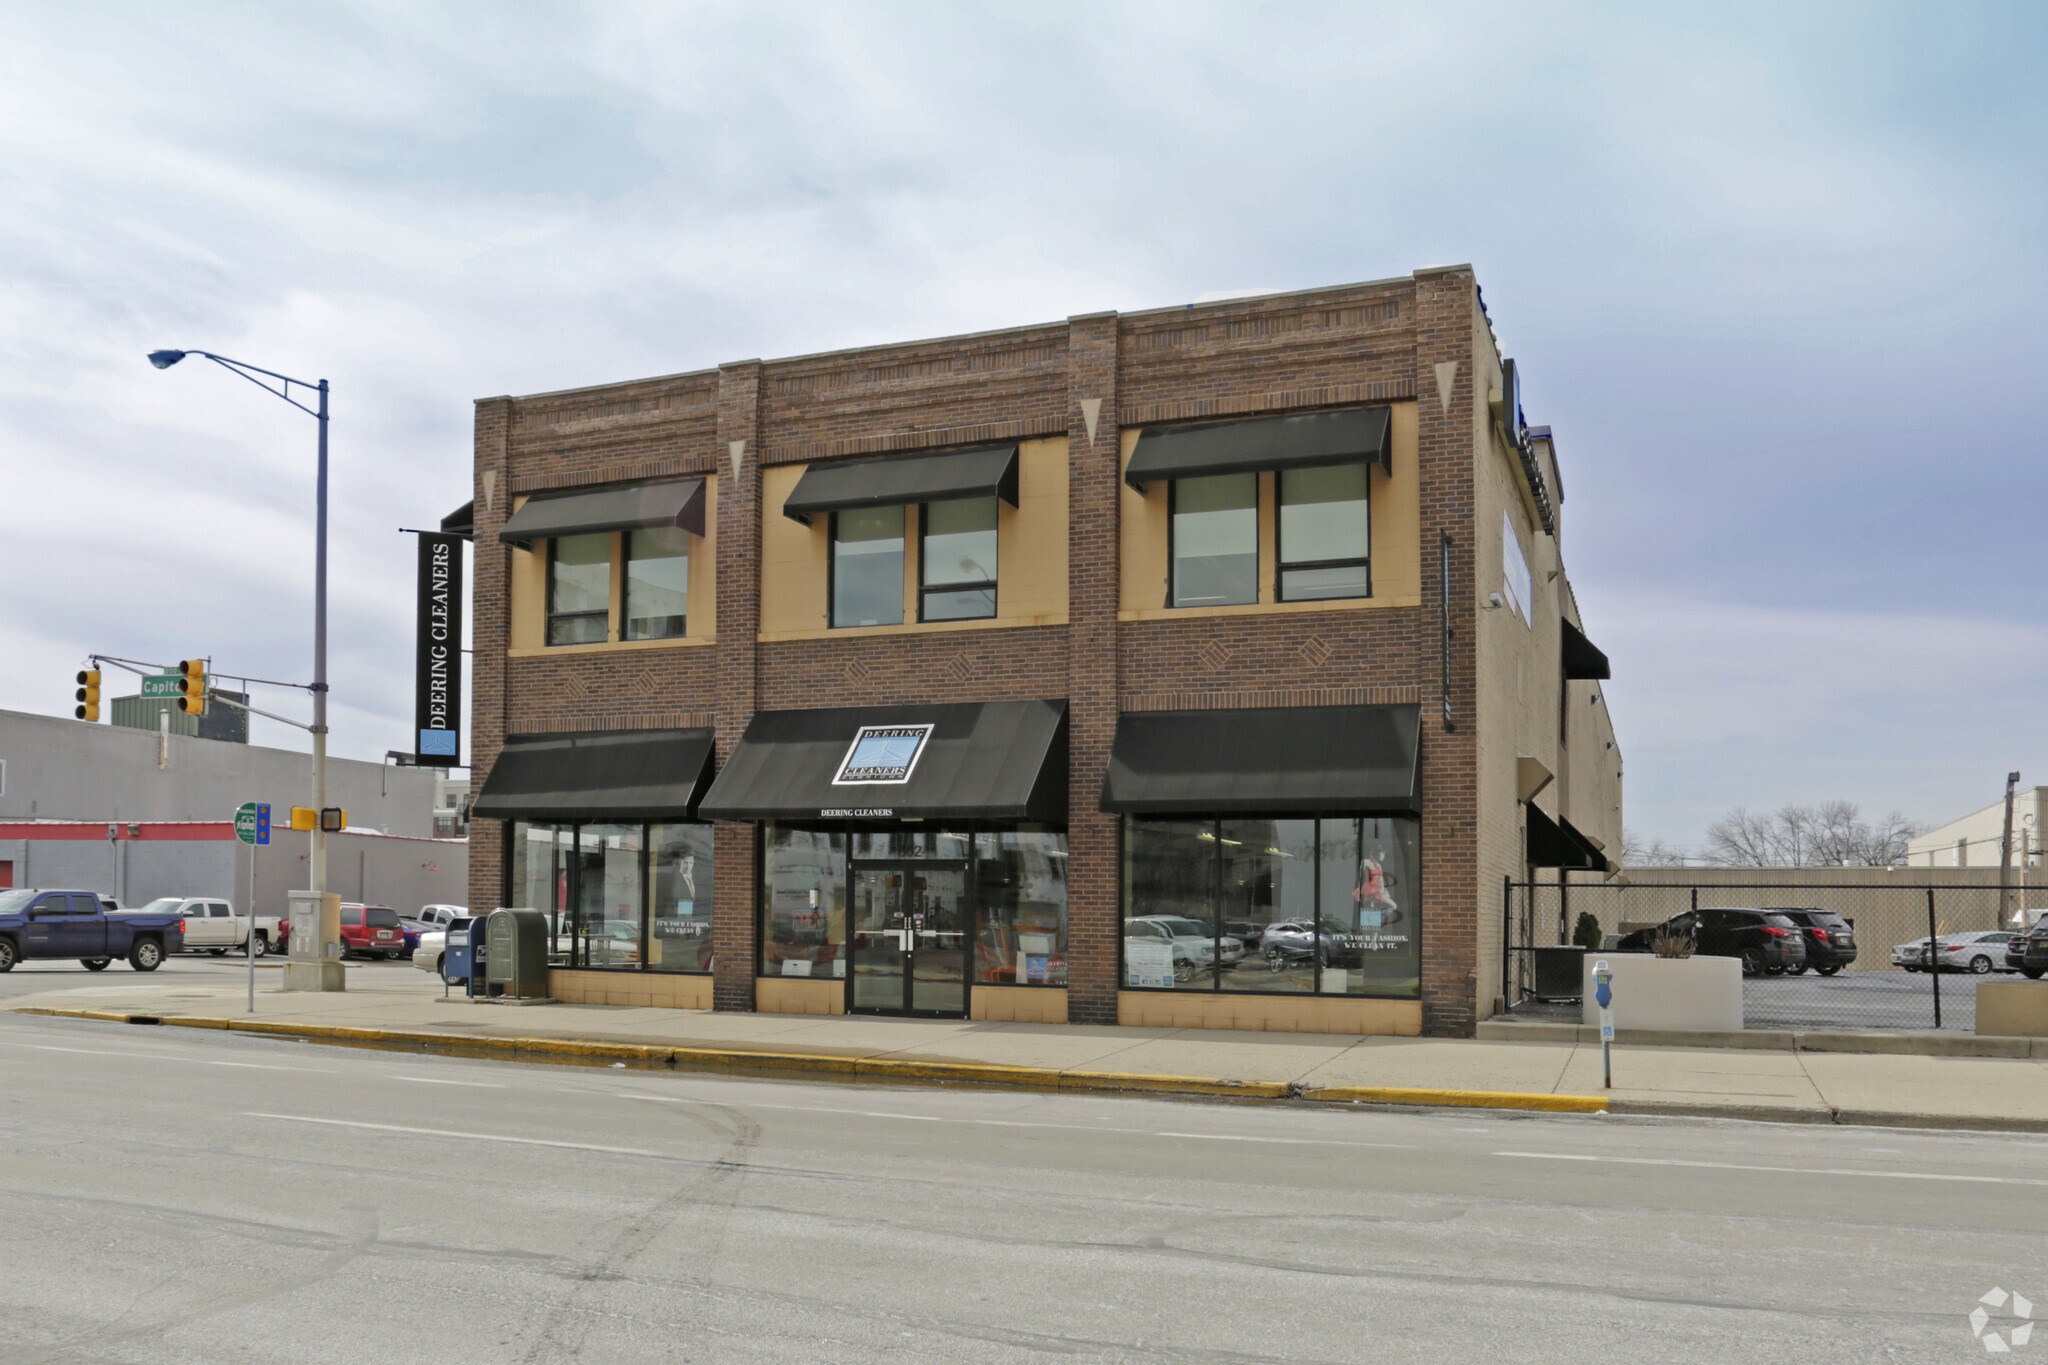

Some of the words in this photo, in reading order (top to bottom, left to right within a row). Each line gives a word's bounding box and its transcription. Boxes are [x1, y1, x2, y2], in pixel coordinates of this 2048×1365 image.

[431, 543, 449, 641] CLEANERS
[431, 646, 447, 730] DEERING
[864, 729, 924, 738] DEERING
[845, 766, 906, 775] CLEANERS
[821, 809, 853, 817] DEERING
